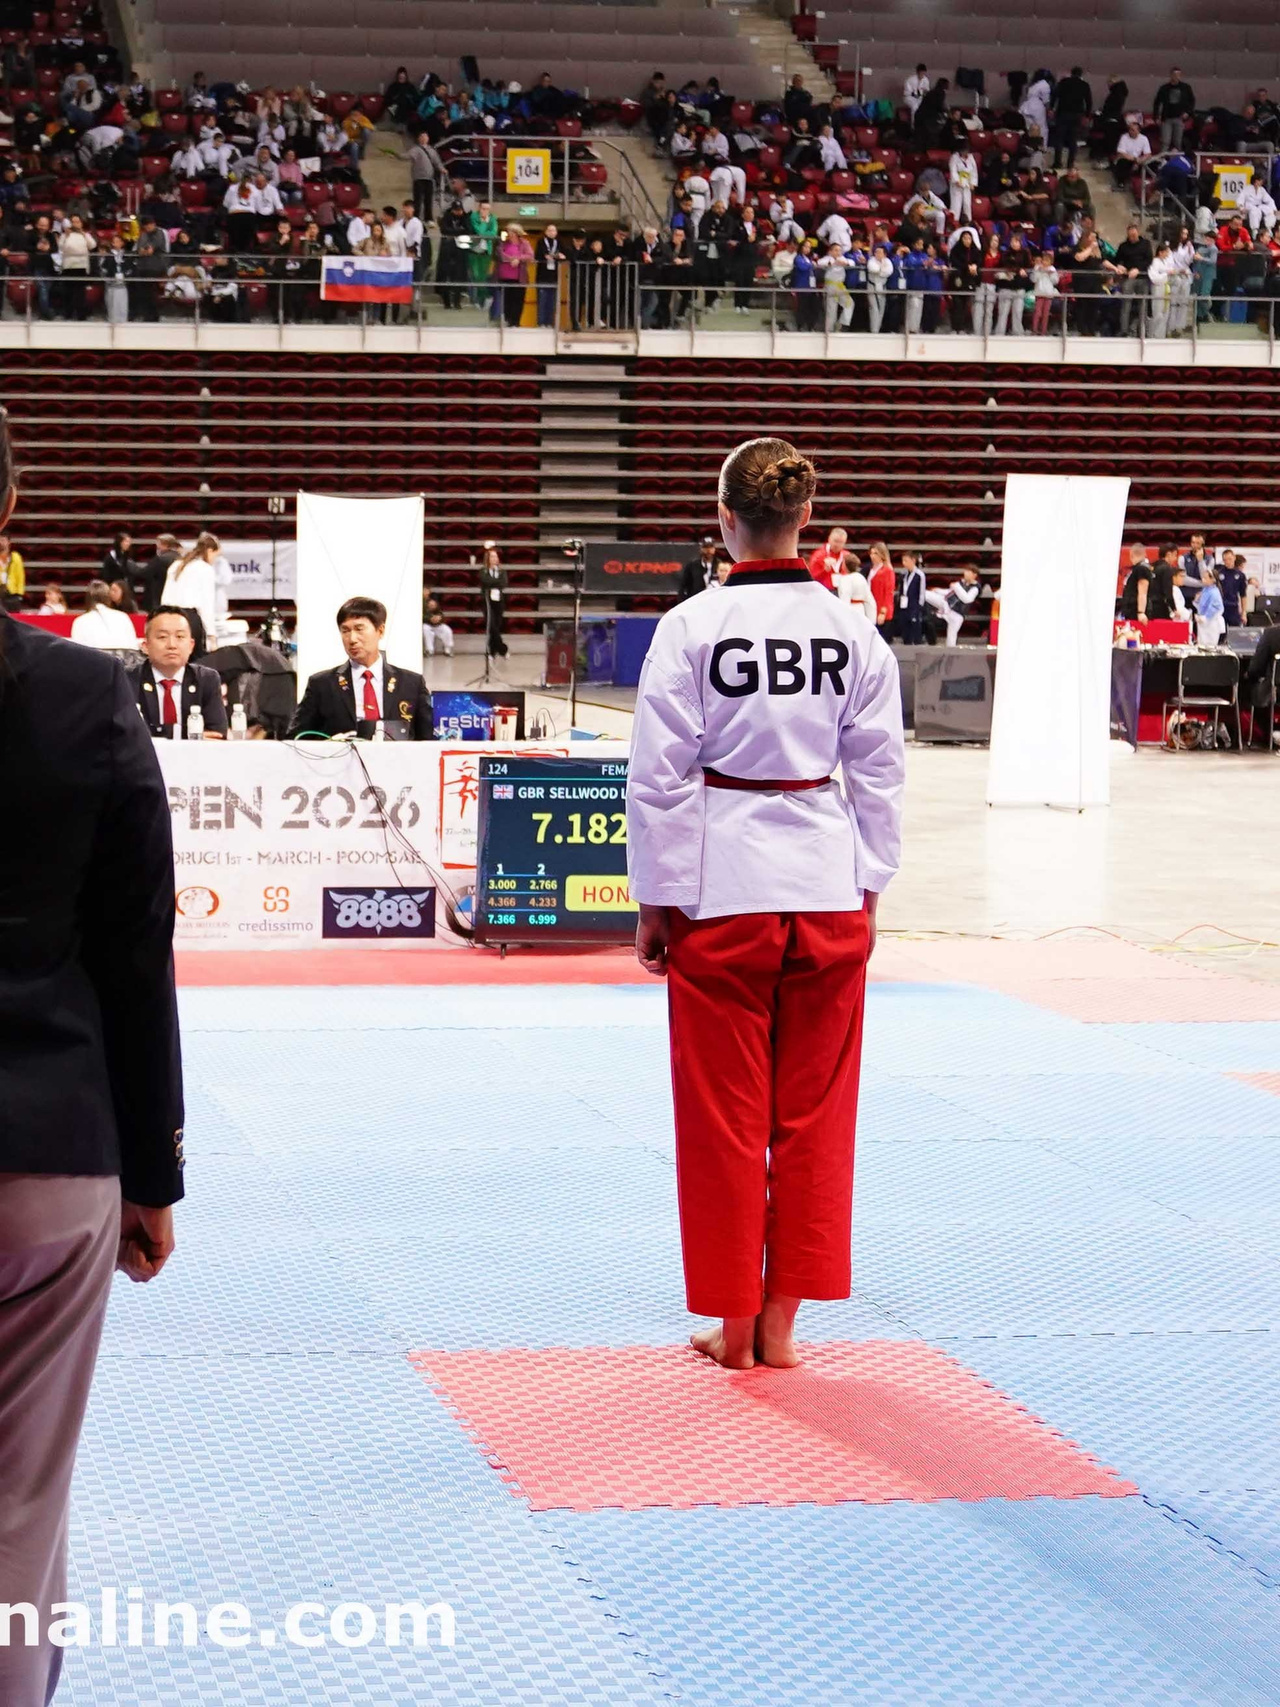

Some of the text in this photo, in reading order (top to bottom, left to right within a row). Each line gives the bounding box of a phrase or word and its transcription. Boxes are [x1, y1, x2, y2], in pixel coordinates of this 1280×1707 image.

[517, 164, 540, 178] 104
[710, 637, 850, 697] GBR
[440, 714, 494, 729] reStri
[488, 764, 508, 775] 124
[601, 764, 629, 776] FEMA
[518, 787, 545, 799] GBR
[549, 787, 618, 800] SELLWOOD
[169, 785, 421, 830] PEN 2026
[531, 812, 627, 845] 7.182
[257, 851, 321, 865] MARCH
[336, 851, 421, 865] POOMSAE
[496, 863, 546, 875] 1 2
[488, 879, 558, 890] 3.000 2.766
[583, 886, 630, 903] HON
[488, 897, 557, 908] 4.366 4.233
[336, 898, 422, 928] 8888
[488, 914, 557, 925] 7.366 6.999
[238, 919, 314, 932] credissimo
